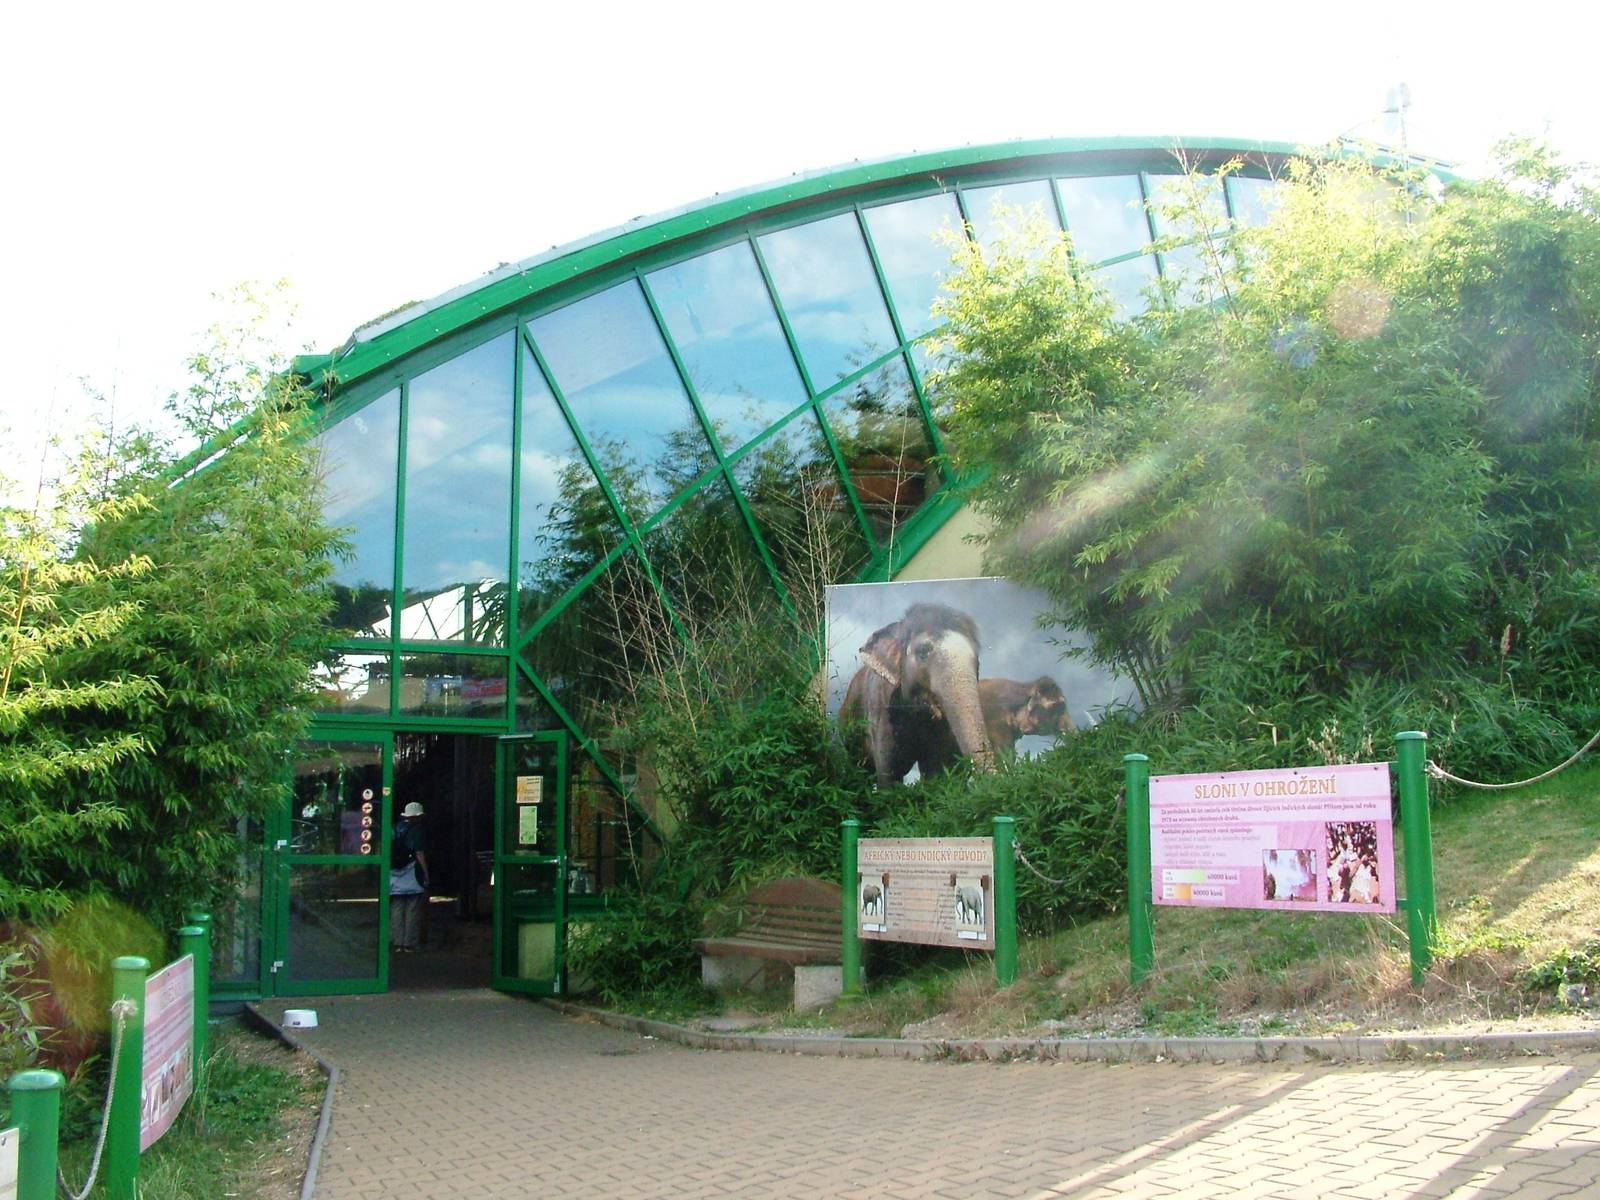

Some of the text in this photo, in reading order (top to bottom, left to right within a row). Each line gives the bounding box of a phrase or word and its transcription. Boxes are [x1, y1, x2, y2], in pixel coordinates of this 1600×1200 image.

[1194, 775, 1336, 800] SLONI V OHROŽENÍ
[896, 849, 915, 861] NEBO
[918, 847, 952, 862] INDICKÝ
